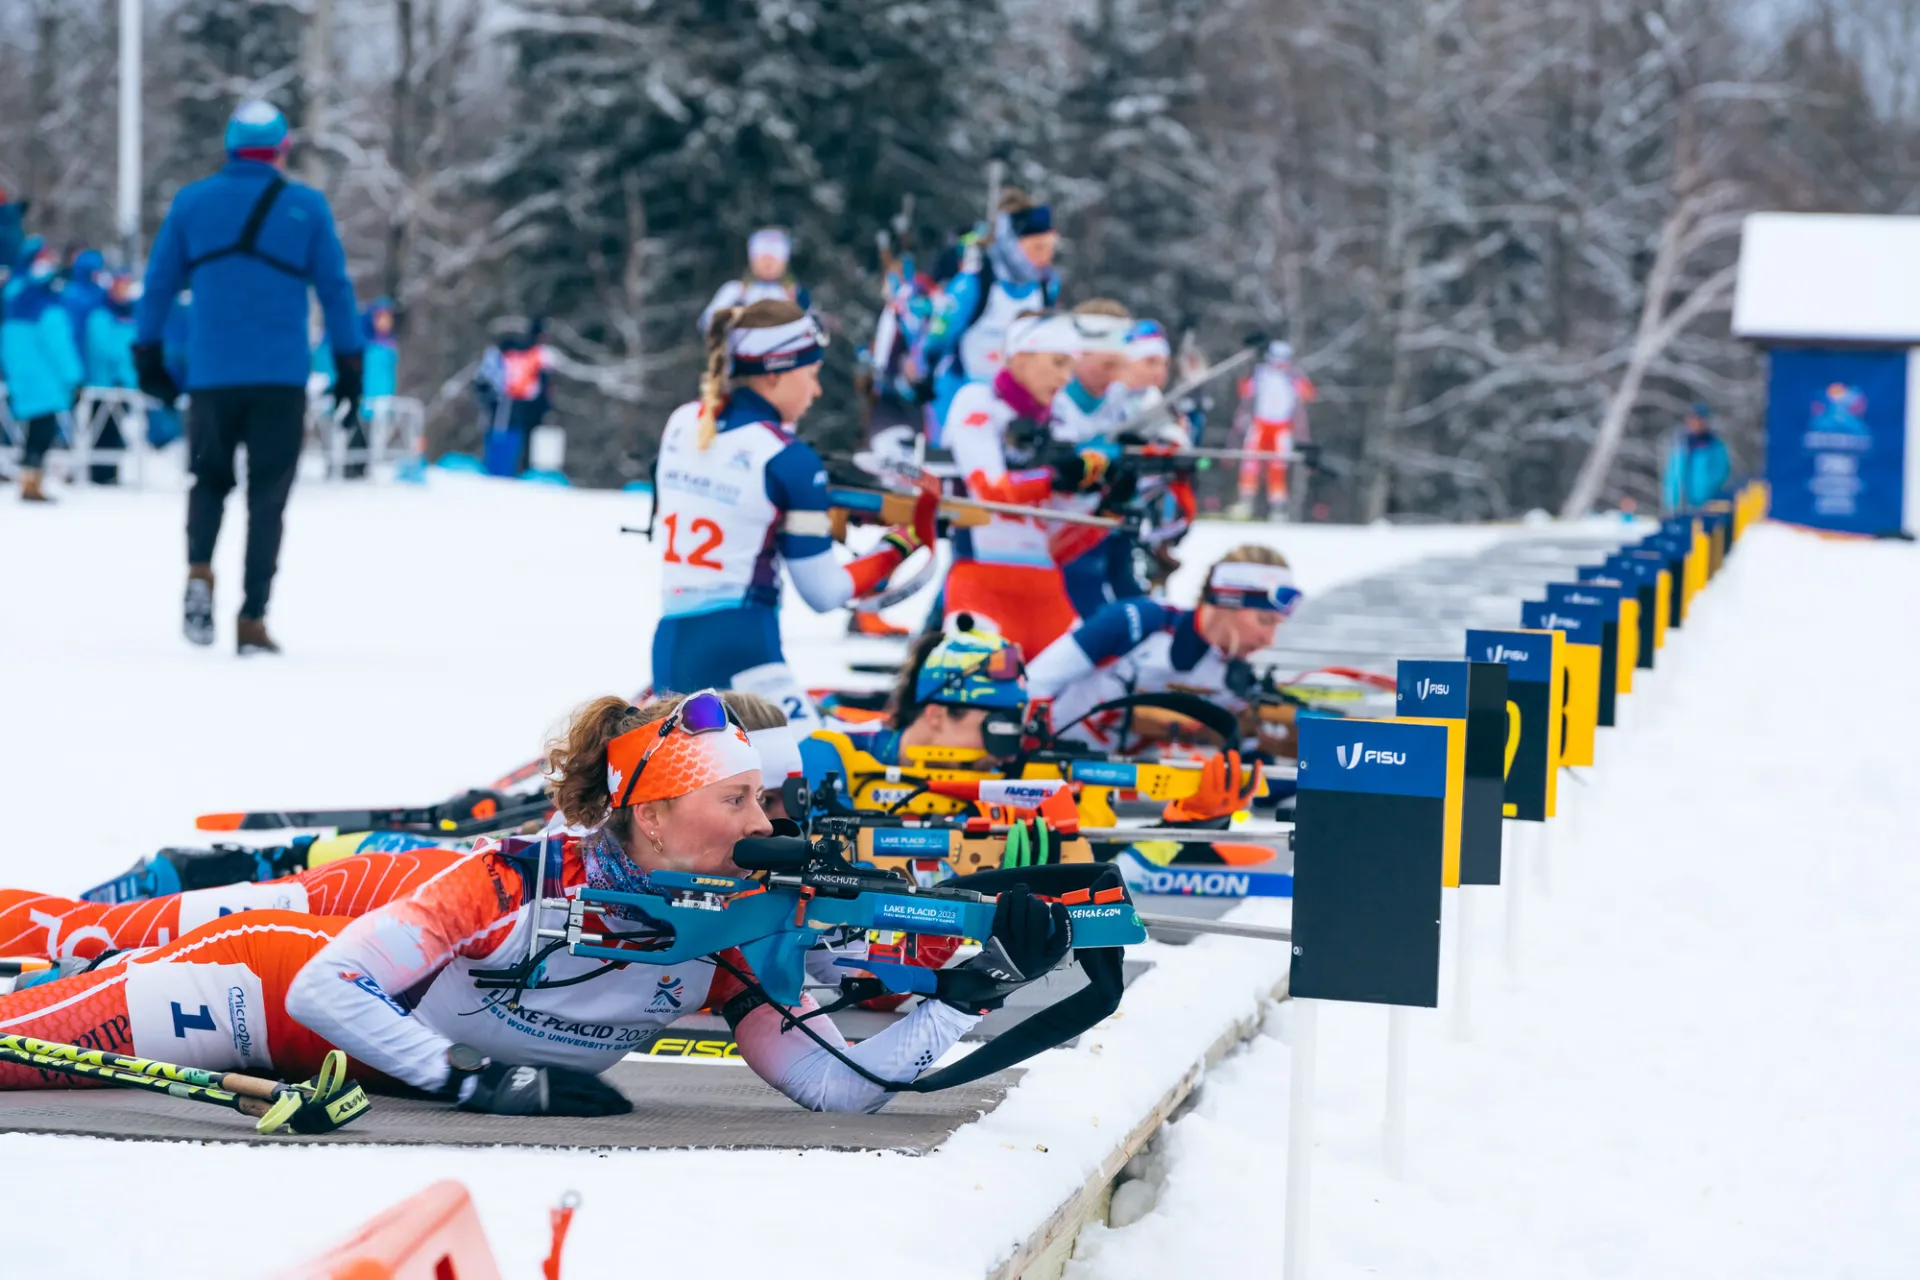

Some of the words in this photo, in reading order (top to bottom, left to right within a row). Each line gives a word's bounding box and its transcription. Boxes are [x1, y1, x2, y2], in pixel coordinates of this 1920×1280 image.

[663, 511, 724, 572] 12
[1503, 648, 1529, 662] FISU
[1429, 683, 1450, 695] FISU
[782, 695, 808, 719] 2
[1364, 749, 1406, 766] FISU
[883, 904, 906, 913] LAKE
[907, 906, 937, 917] PLACID
[937, 910, 956, 919] 2023
[170, 1001, 217, 1039] 1
[542, 1016, 614, 1040] PLACID
[506, 1017, 546, 1038] WORLD
[547, 1033, 613, 1051] UNIVERSITY
